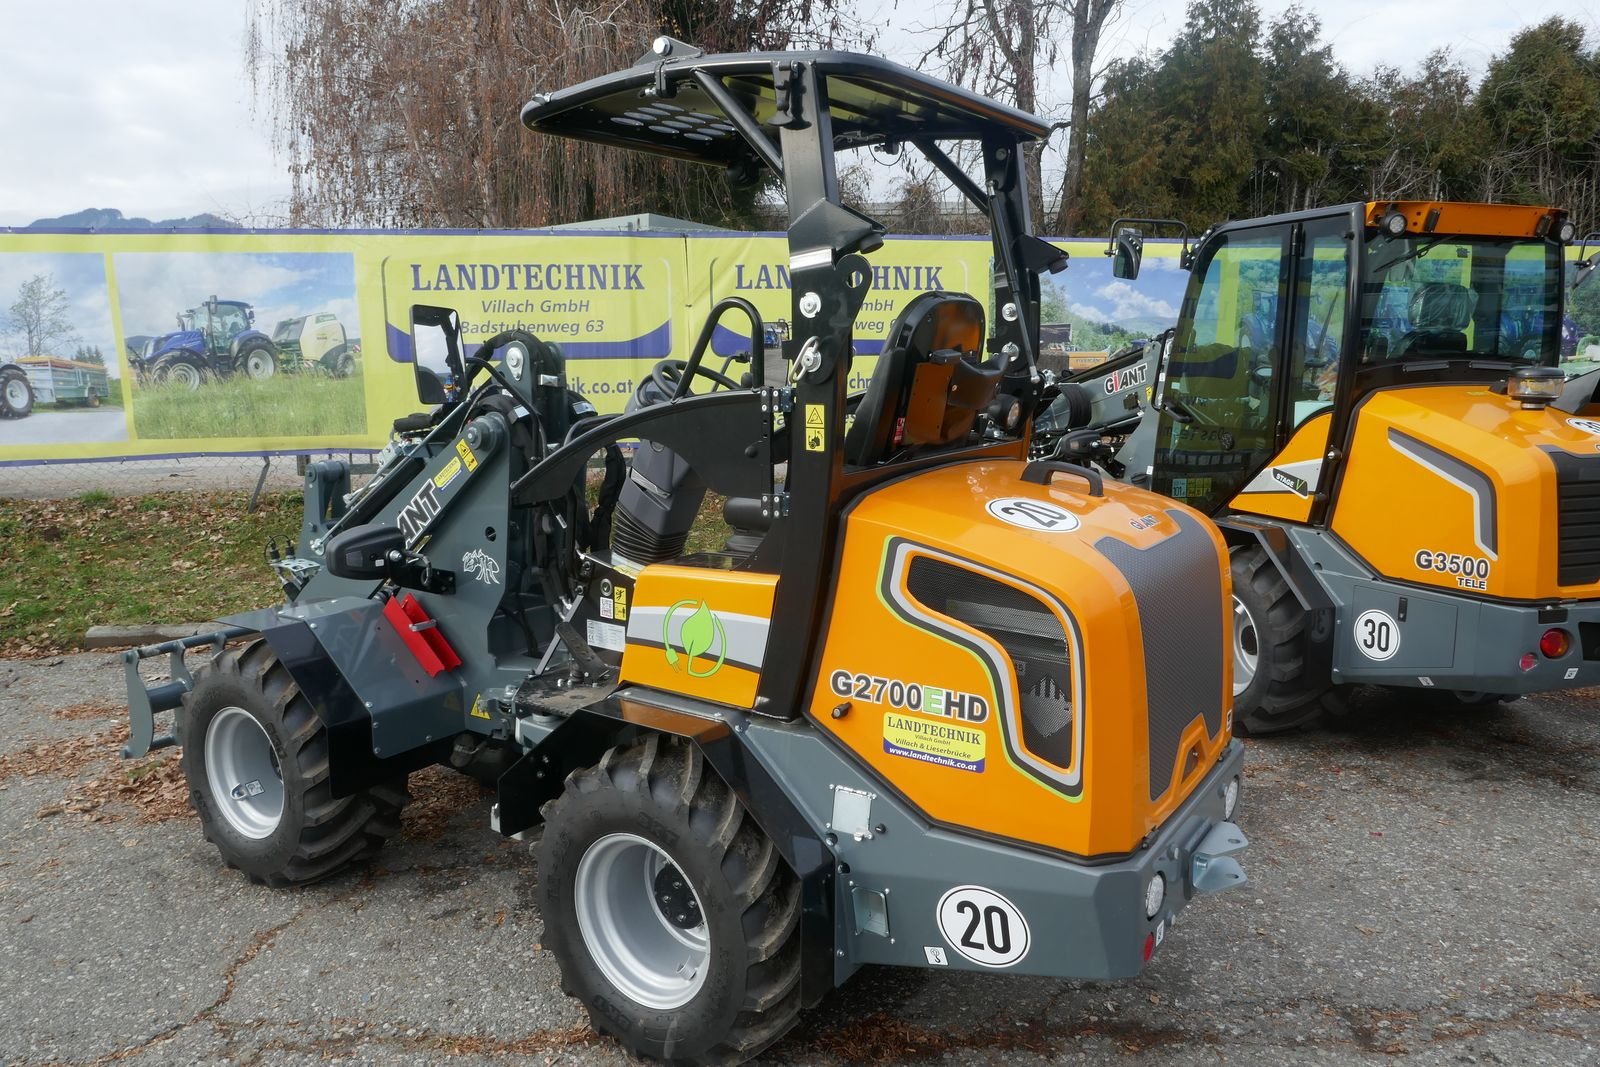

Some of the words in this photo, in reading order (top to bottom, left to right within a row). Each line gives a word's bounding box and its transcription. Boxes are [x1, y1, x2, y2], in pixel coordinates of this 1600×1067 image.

[410, 264, 645, 291] LANDTECHNIK
[735, 264, 944, 291] LANHNIK
[482, 300, 534, 313] Villach
[540, 300, 589, 313] GmbH
[860, 300, 894, 312] mbH
[461, 320, 580, 336] Badstubenweg
[585, 320, 604, 333] 63
[1275, 473, 1295, 488] STAGE
[397, 478, 442, 550] ANT
[1001, 501, 1068, 529] 20
[1415, 549, 1490, 579] G3500
[1457, 577, 1487, 590] TELE
[1363, 618, 1390, 652] 30
[830, 670, 989, 723] G2700EHD
[887, 716, 981, 745] LANDTECHNIK
[895, 738, 919, 749] Villach
[889, 746, 977, 771] www.landtechnik.co.at
[957, 900, 1011, 954] 20
